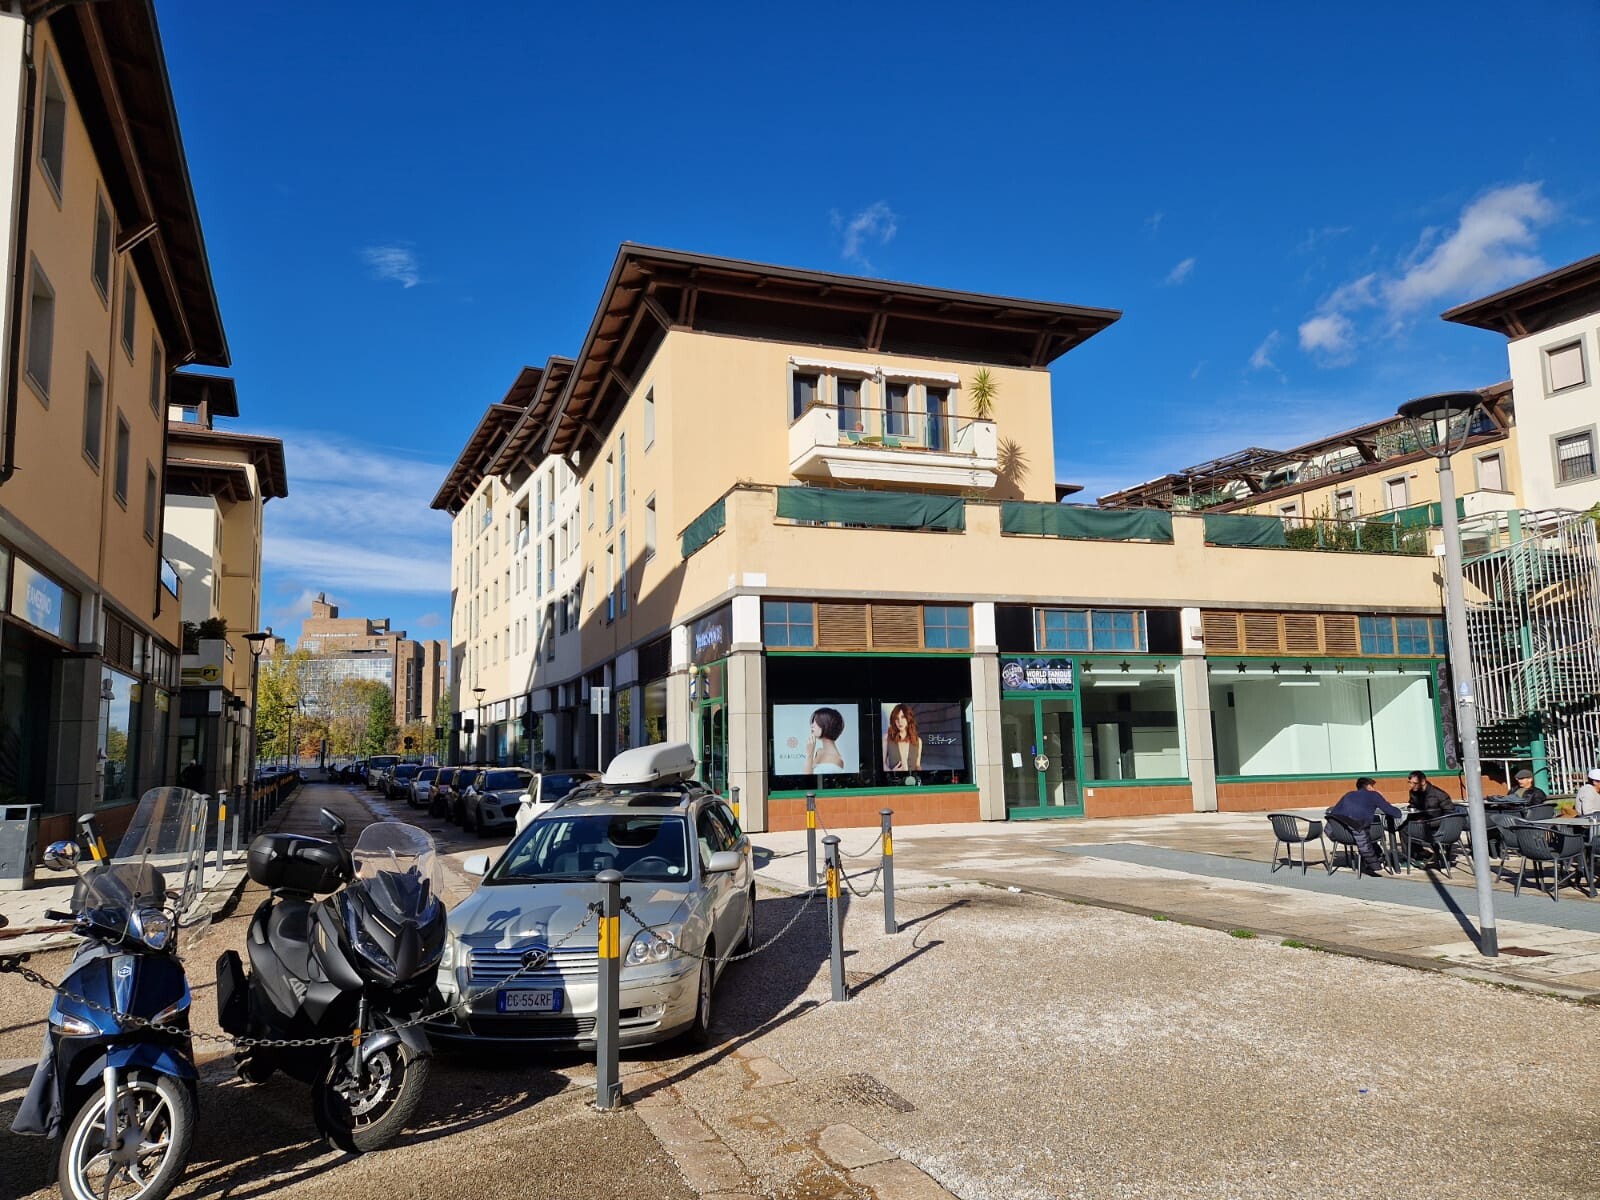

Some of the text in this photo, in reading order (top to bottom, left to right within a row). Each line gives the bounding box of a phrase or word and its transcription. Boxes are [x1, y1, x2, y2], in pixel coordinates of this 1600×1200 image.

[203, 668, 218, 676] PT
[1026, 670, 1047, 678] WORLD
[1047, 670, 1072, 678] FAMOUS
